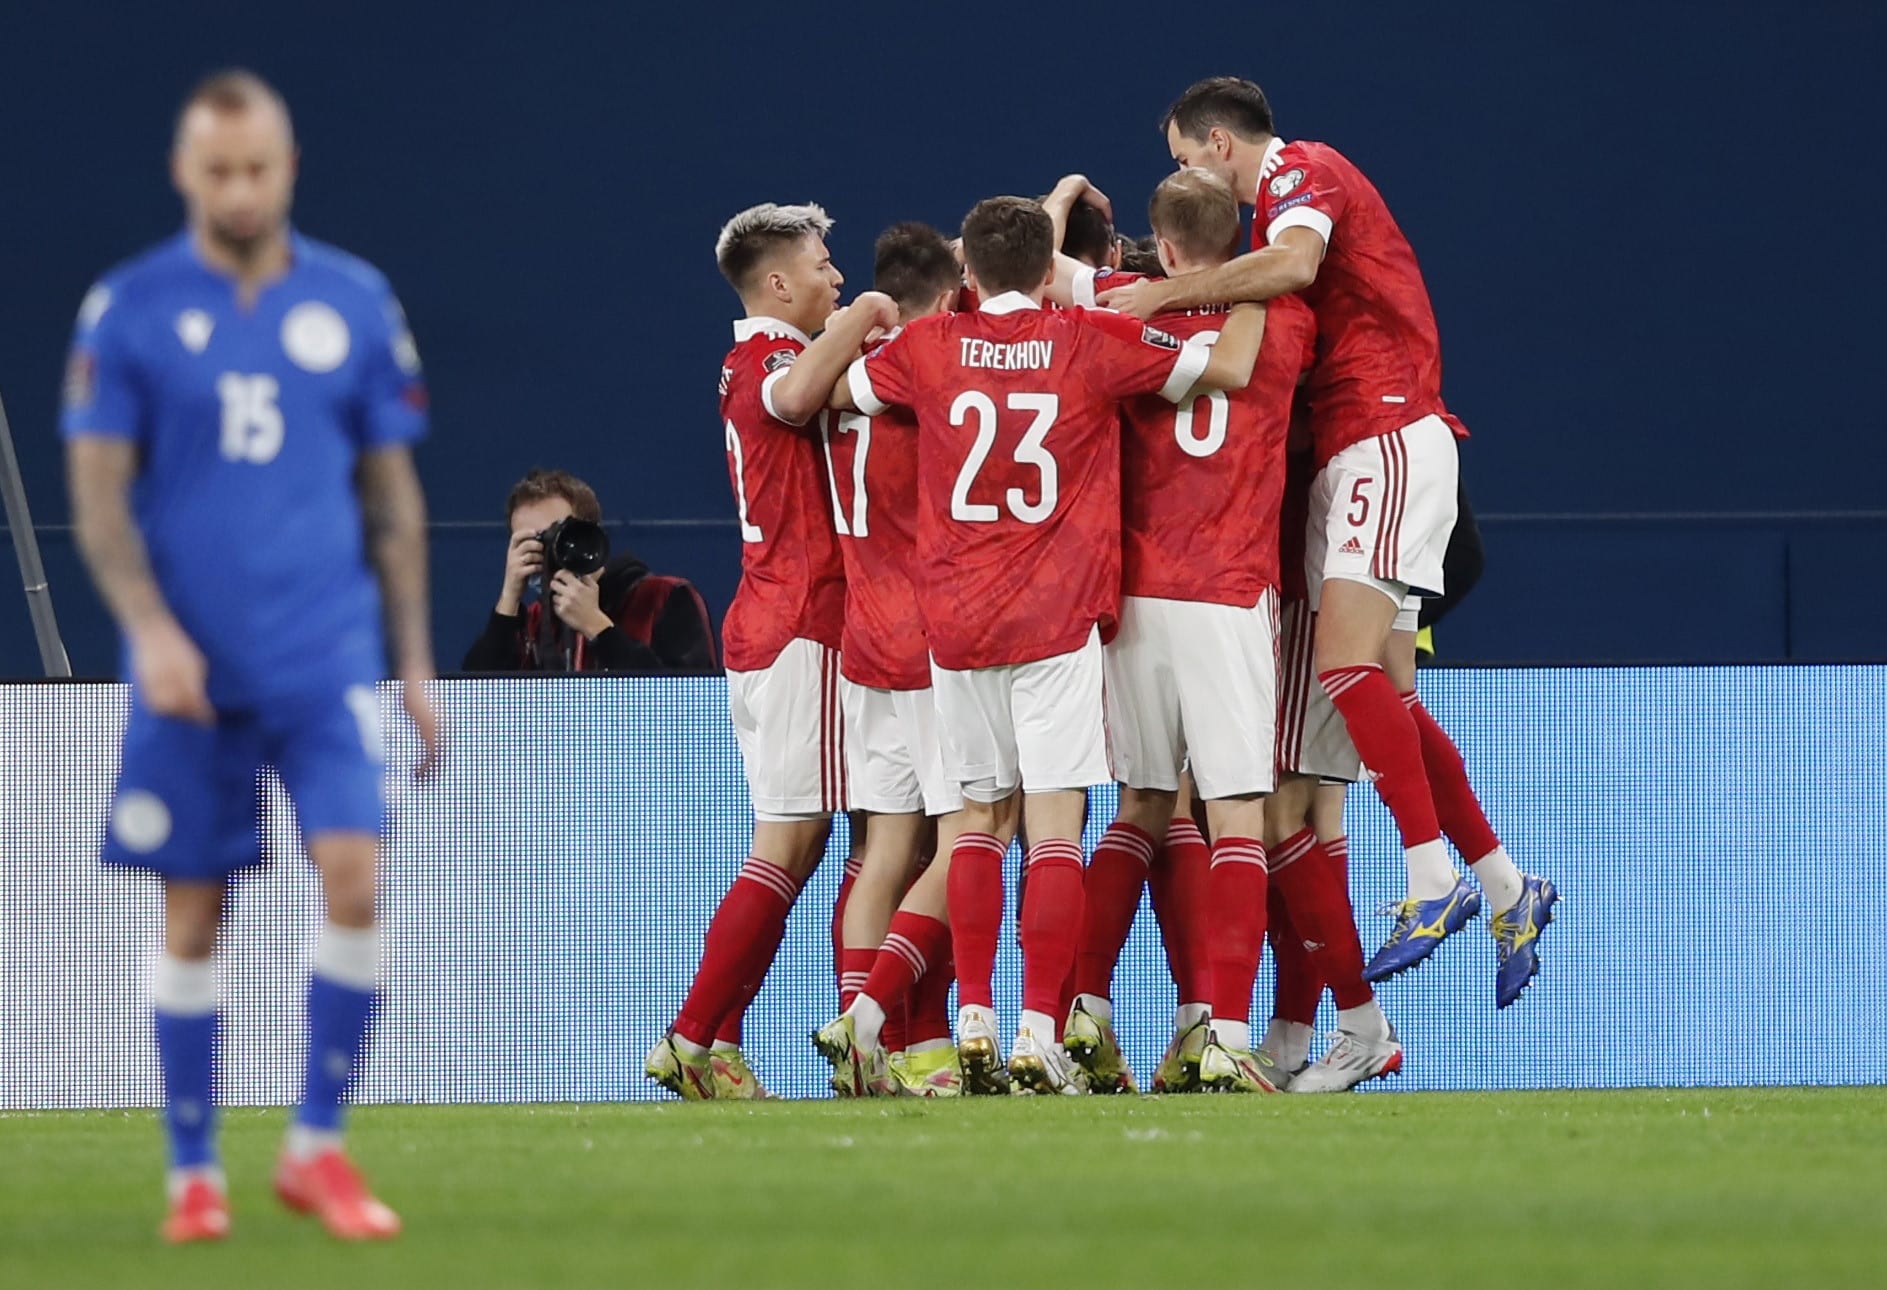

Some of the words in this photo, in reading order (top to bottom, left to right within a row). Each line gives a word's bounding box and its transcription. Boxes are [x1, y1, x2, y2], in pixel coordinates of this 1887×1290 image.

[960, 336, 1054, 370] TEREKHOV
[217, 370, 285, 463] 15
[948, 390, 1059, 524] 23
[1347, 477, 1374, 527] 5
